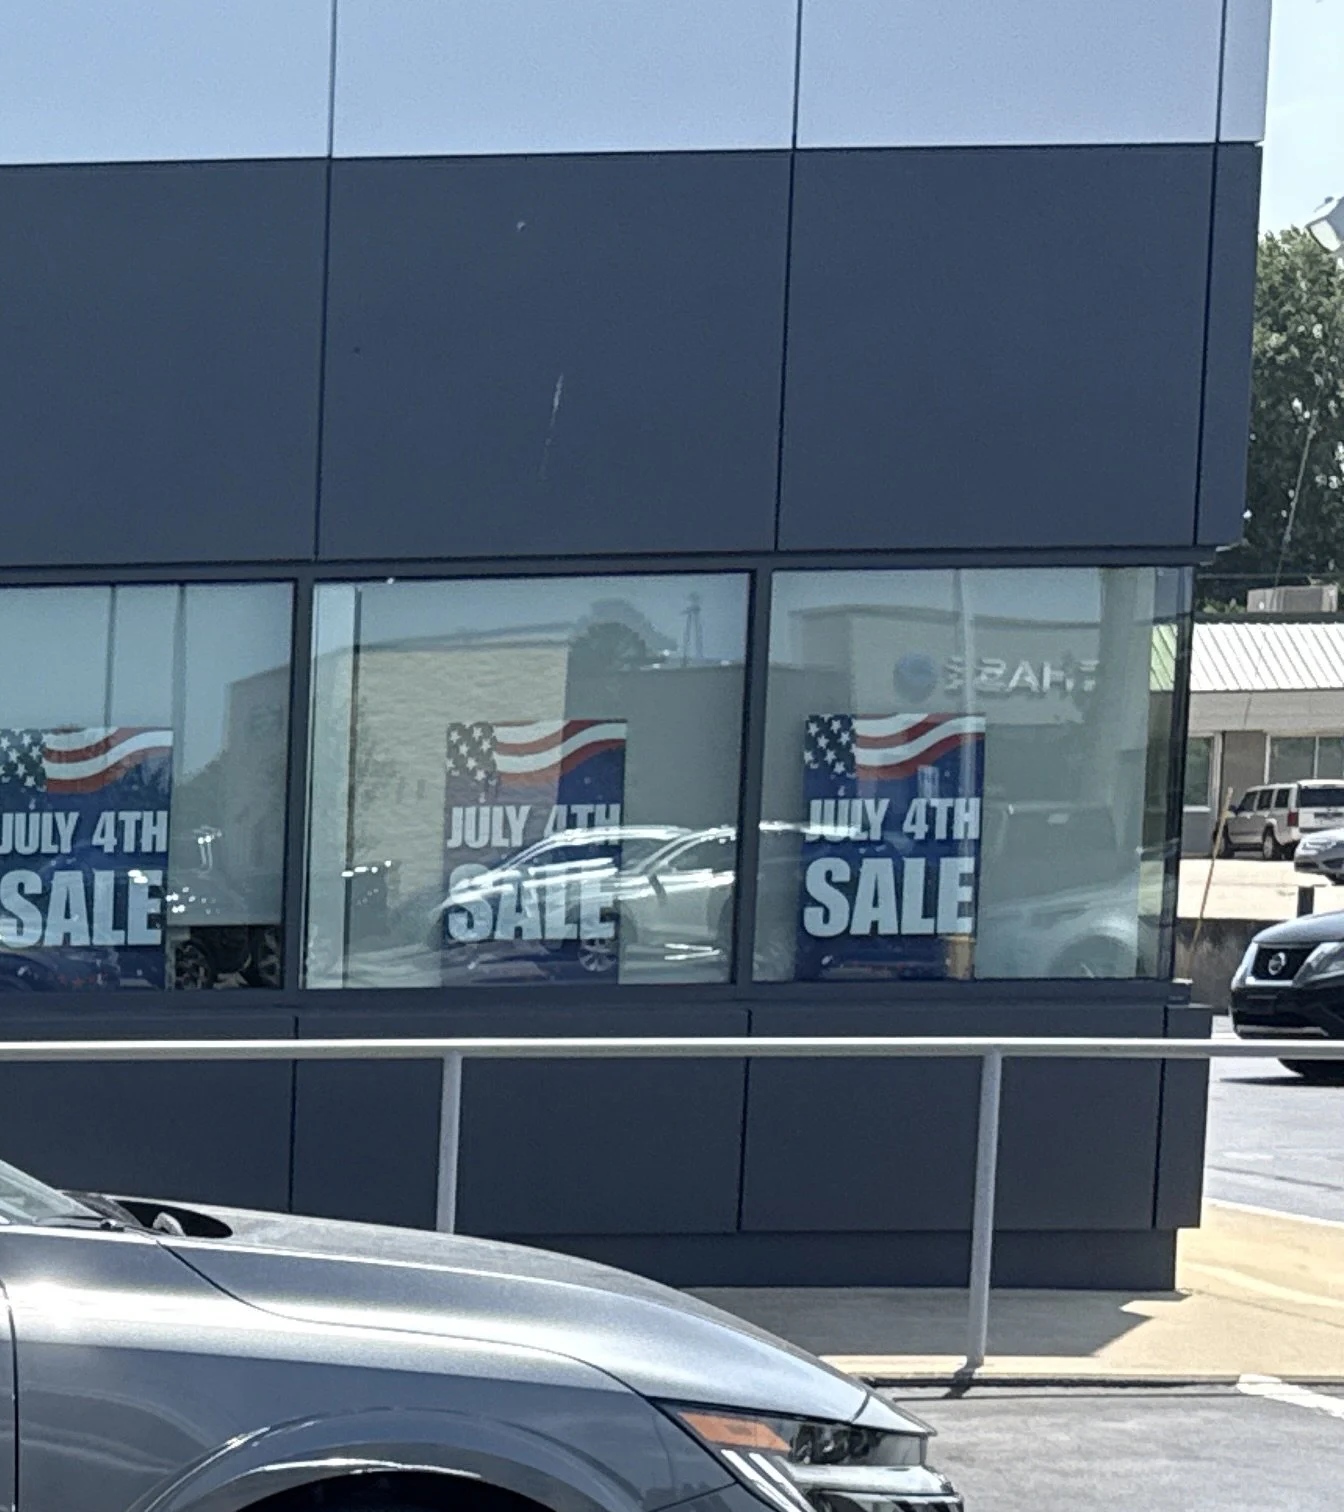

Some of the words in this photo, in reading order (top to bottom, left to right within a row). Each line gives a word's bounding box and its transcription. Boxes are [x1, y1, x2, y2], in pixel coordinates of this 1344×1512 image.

[91, 811, 168, 853] 4TH
[446, 805, 531, 848] JULY
[542, 803, 621, 846] 4TH
[804, 798, 890, 842] JULY
[902, 798, 981, 839] 4TH
[0, 869, 162, 948] SALE
[448, 863, 615, 942] SALE
[803, 857, 975, 937] SALE
